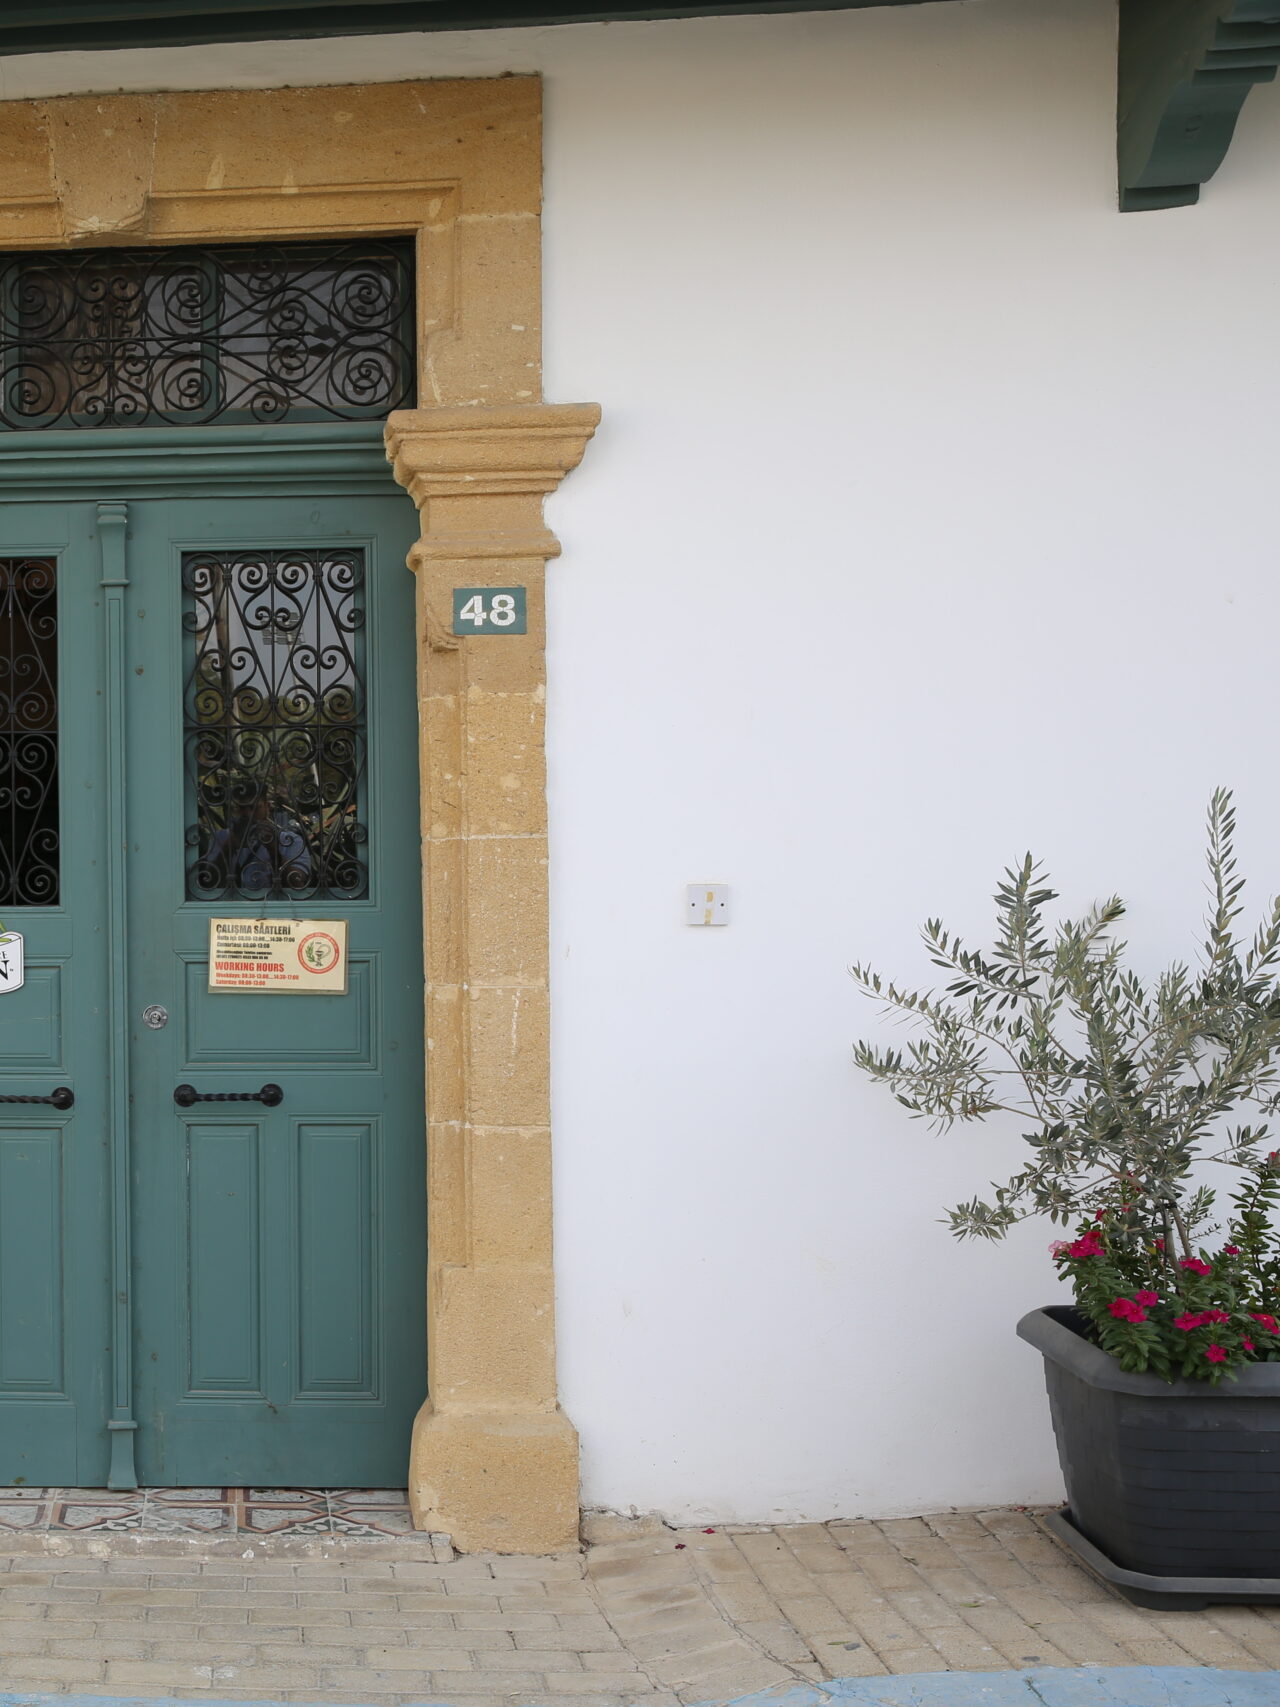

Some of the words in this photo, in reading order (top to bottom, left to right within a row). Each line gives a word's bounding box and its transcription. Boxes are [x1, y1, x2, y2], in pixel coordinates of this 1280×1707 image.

[460, 594, 516, 626] 48
[215, 962, 255, 971] WORKING
[256, 963, 285, 972] HOURS
